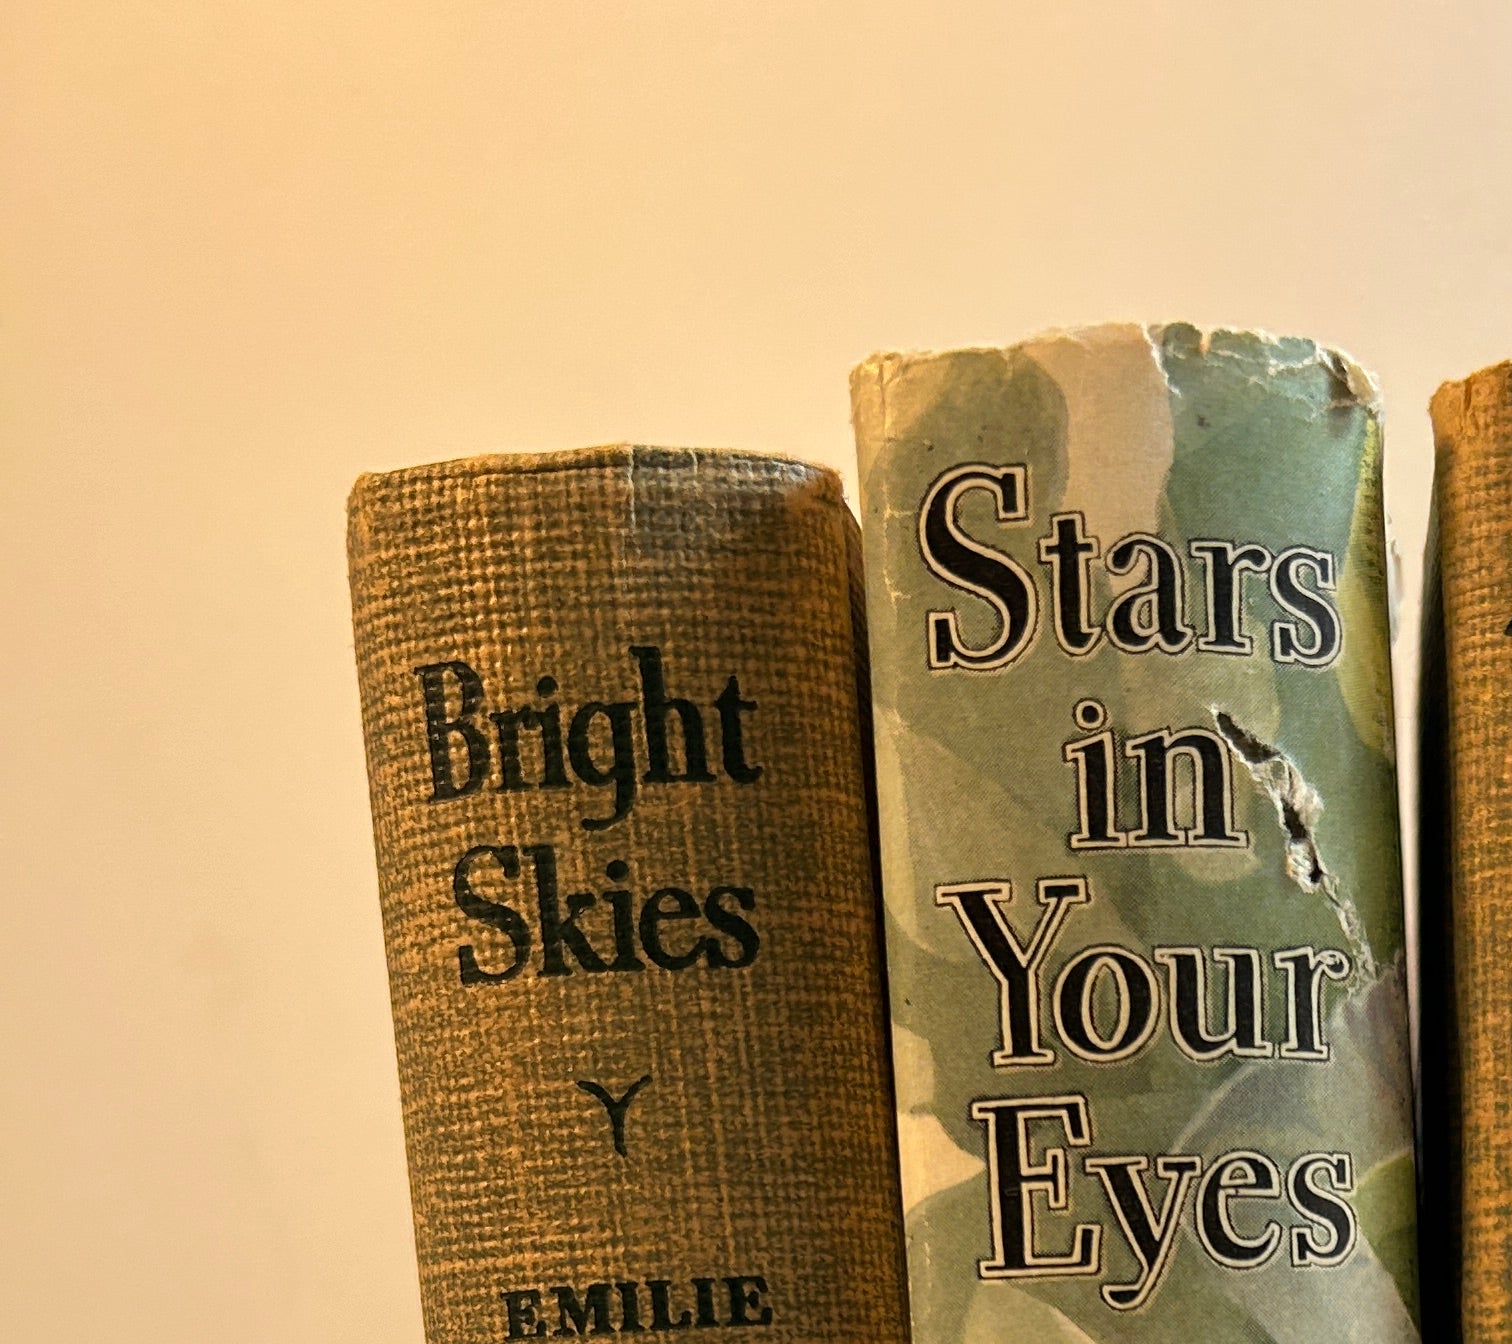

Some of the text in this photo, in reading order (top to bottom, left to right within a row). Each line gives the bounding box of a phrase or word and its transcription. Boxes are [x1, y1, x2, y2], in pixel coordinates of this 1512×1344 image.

[919, 462, 1342, 671] Stars
[414, 646, 763, 831] Bright
[1065, 698, 1249, 850] in
[453, 845, 760, 987] Skies
[936, 877, 1350, 1068] Your
[970, 1095, 1358, 1311] Eyes
[501, 1275, 774, 1343] EMILIE
